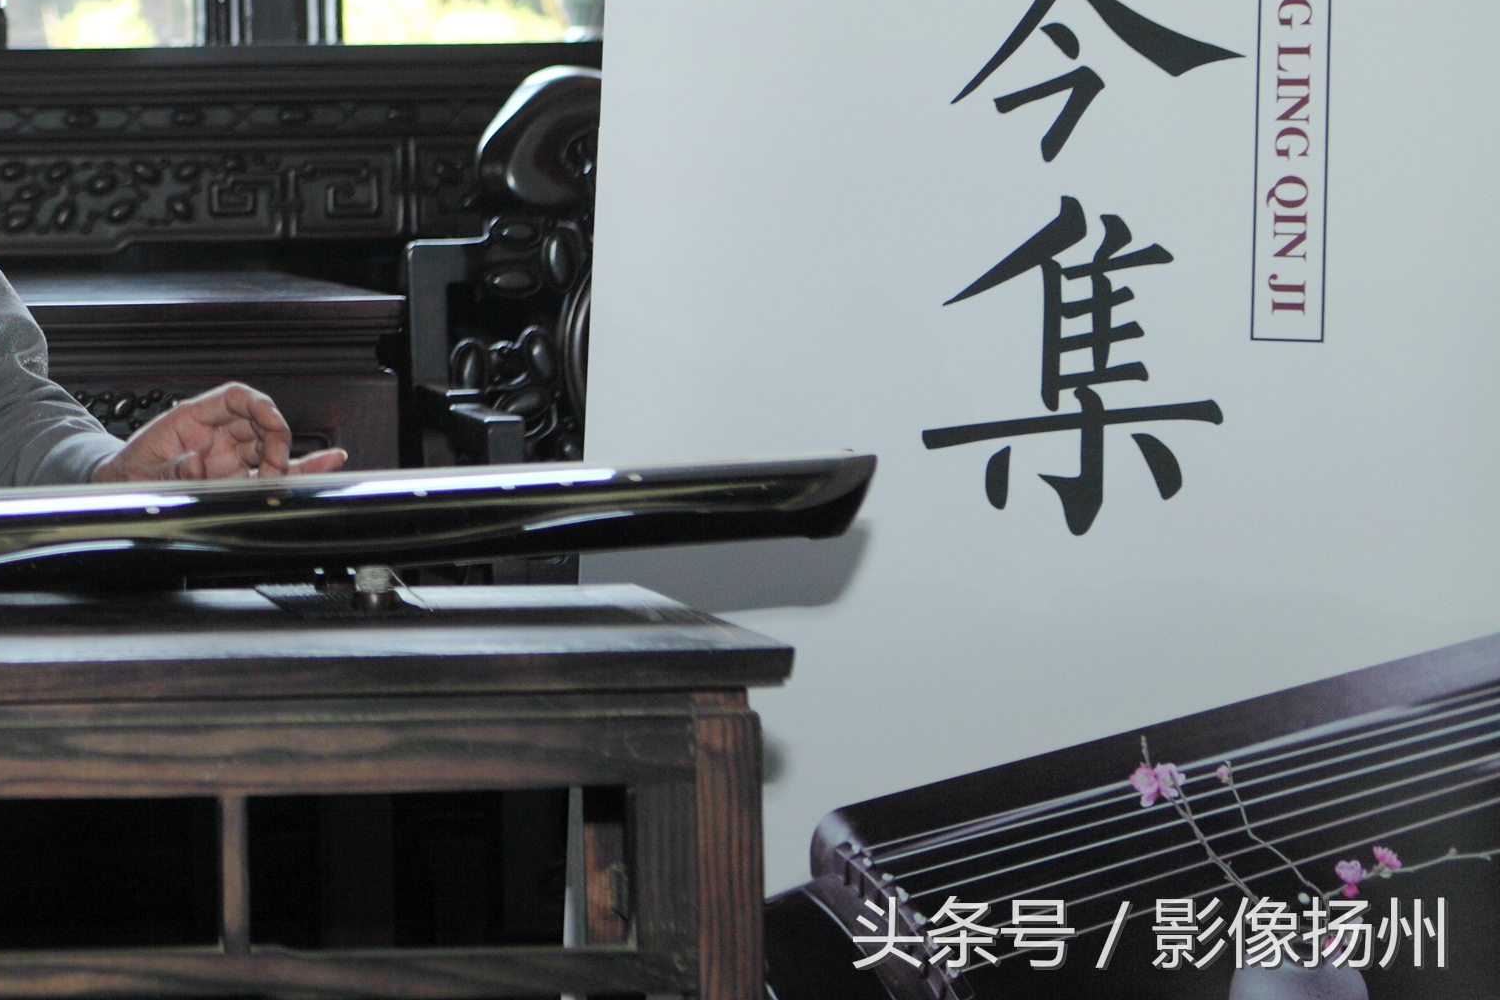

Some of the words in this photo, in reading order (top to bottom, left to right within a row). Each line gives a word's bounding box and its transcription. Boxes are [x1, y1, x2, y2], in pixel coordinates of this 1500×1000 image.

[1275, 42, 1312, 162] LING
[1266, 175, 1309, 262] QIN
[1267, 273, 1307, 316] JI
